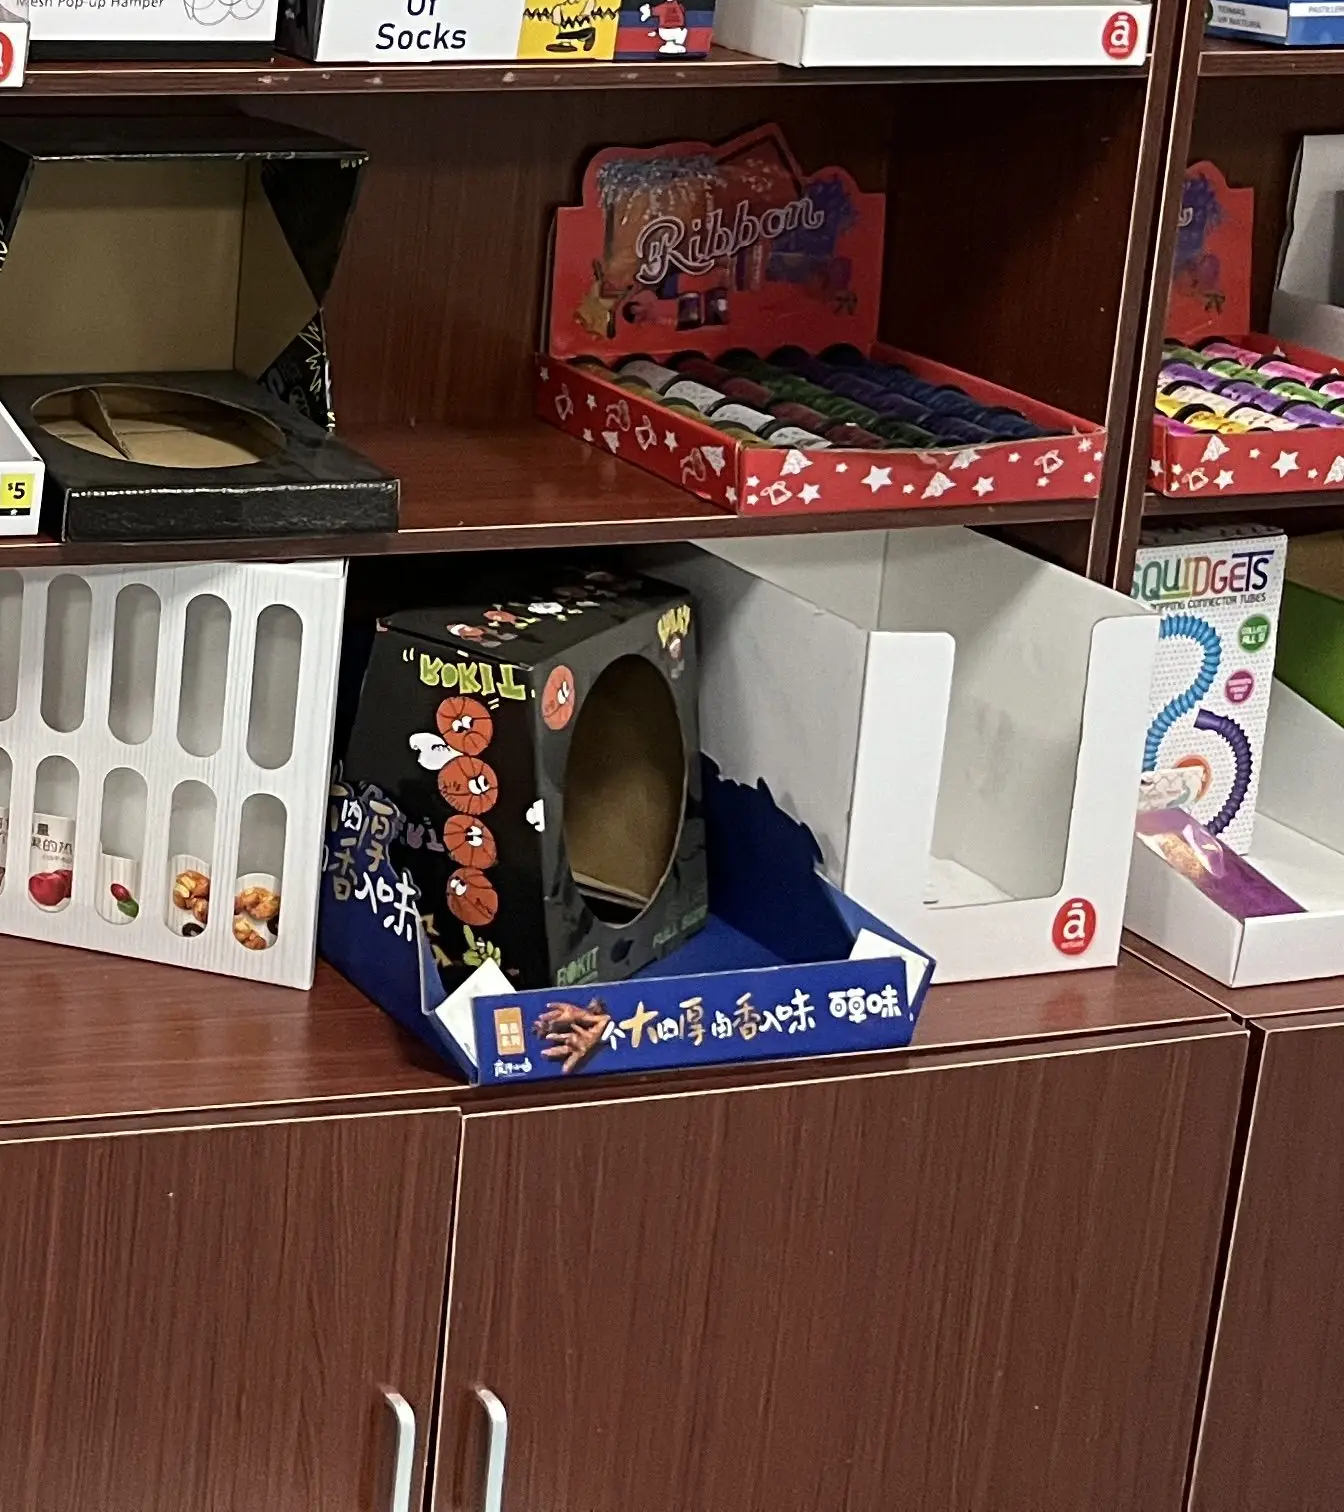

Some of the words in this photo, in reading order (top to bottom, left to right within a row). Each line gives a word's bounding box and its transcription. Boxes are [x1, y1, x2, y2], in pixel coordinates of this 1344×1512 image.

[375, 22, 468, 51] Socks
[634, 196, 826, 286] Ribbon
[7, 482, 26, 500] $5
[1187, 597, 1237, 609] CONNECTOR
[1240, 592, 1266, 605] TUBES
